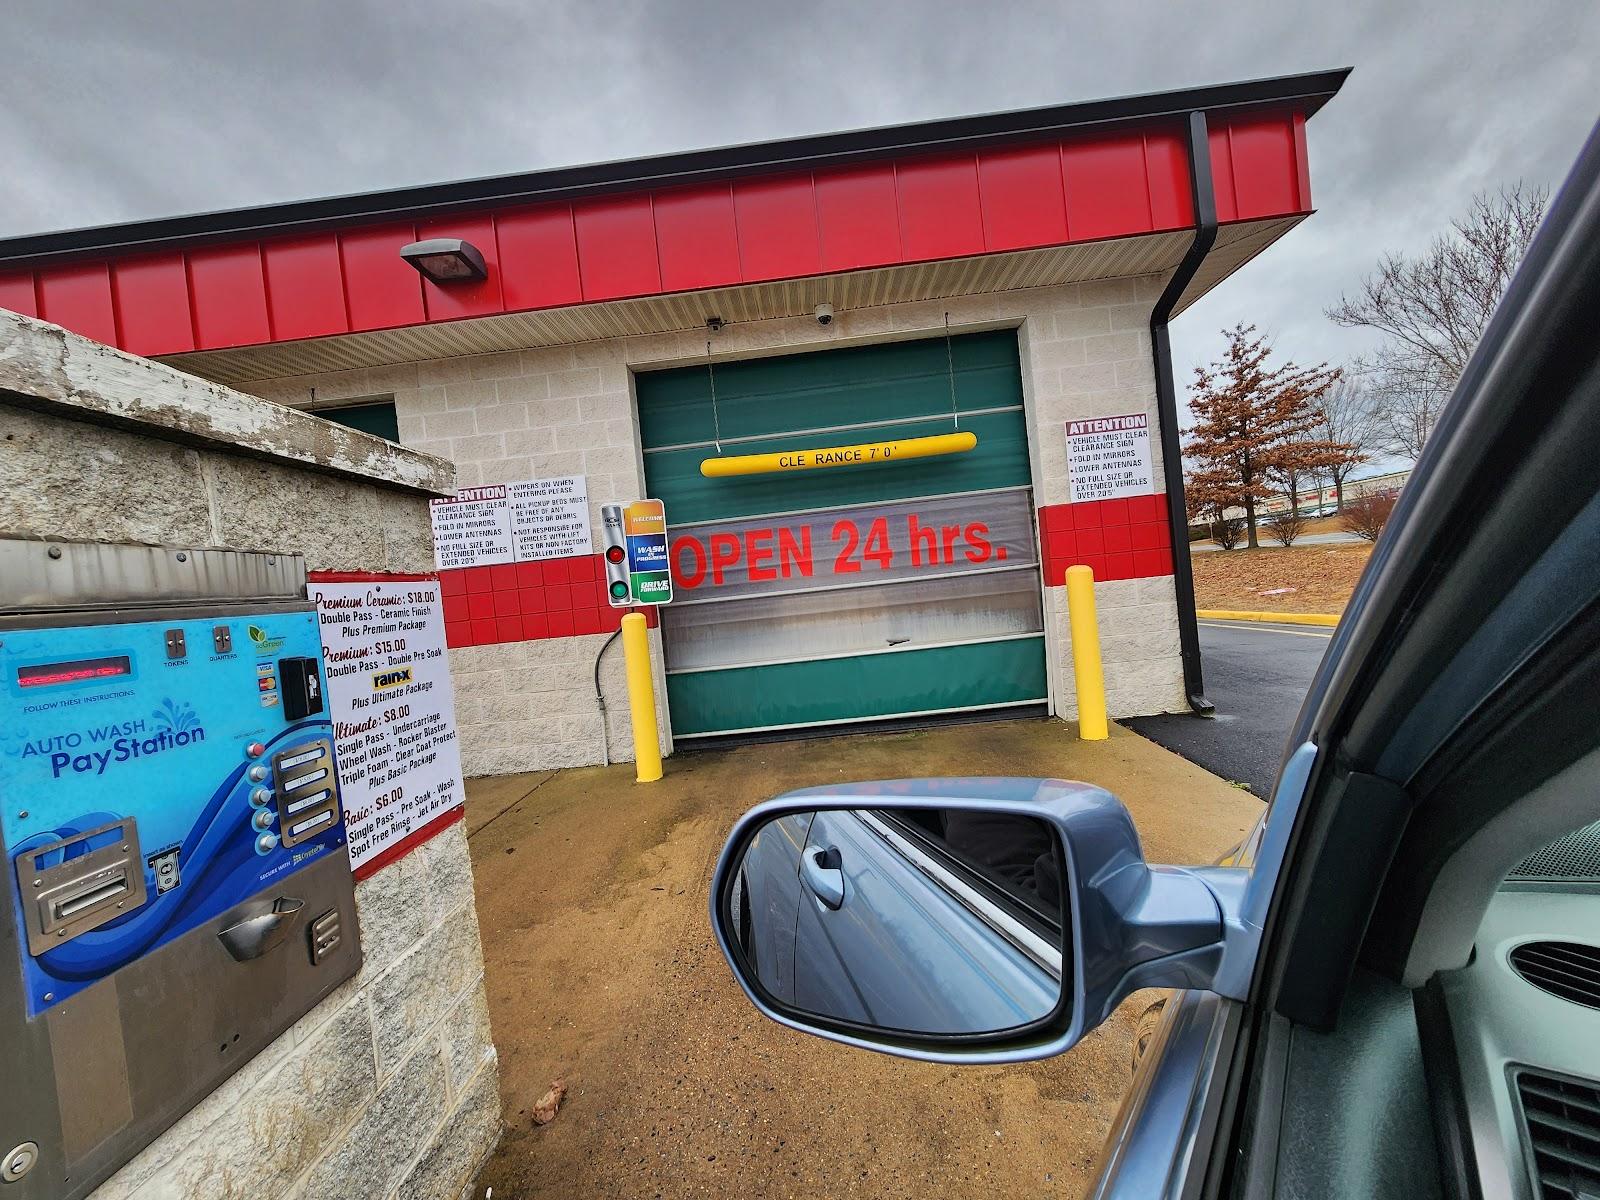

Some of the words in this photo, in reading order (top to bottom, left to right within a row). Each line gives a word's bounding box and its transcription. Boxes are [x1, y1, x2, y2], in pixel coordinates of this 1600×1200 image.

[1070, 415, 1146, 434] ATTENTION
[1073, 435, 1100, 444] VEHICLE
[1125, 431, 1148, 439] CLEAR
[1073, 442, 1114, 452] CLEARANCE
[779, 455, 805, 468] CLE
[815, 449, 862, 464] RANCE
[1103, 450, 1135, 459] MIRRORS
[1075, 464, 1100, 472] LOWER
[1103, 460, 1142, 470] ANTENNAS
[1076, 476, 1086, 484] NO
[1089, 474, 1104, 482] FULL
[1107, 472, 1122, 480] SIZE
[1077, 481, 1112, 492] EXTENDED
[1116, 478, 1148, 487] VEHICLES
[434, 487, 505, 504] ENTION
[514, 490, 546, 498] ENTERING
[1078, 491, 1095, 499] OVER
[466, 503, 484, 511] MUST
[438, 512, 476, 521] CLEARANCE
[517, 516, 543, 524] OBJECTS
[633, 515, 664, 523] WELCOME
[466, 520, 496, 528] MIRRORS
[465, 529, 502, 538] ANTENNAS
[520, 535, 549, 543] VEHICLES
[561, 538, 588, 546] FACTORY
[638, 545, 665, 553] WASH
[442, 550, 475, 559] EXTENDED
[477, 547, 508, 555] VEHICLES
[521, 550, 552, 558] INSTALLED
[670, 525, 814, 590] OPEN
[831, 516, 894, 575] 24
[908, 513, 1008, 568] hrs.
[641, 580, 669, 588] DRIVE
[315, 592, 363, 610] Premium
[366, 590, 405, 607] Ceramic:
[407, 591, 435, 603] $18.00
[321, 611, 350, 624] Double
[353, 610, 373, 621] Pass
[381, 608, 409, 619] Ceramic
[412, 606, 431, 616] Finish
[342, 626, 360, 638] Plus
[363, 623, 396, 635] Premium
[398, 620, 426, 632] Package
[210, 653, 237, 662] QUARTERS
[322, 646, 373, 663] Premium:
[375, 639, 405, 655] $15.00
[327, 665, 356, 679] Double
[359, 662, 378, 672] Pass
[388, 654, 411, 666] Double
[414, 651, 425, 661] Pre
[427, 648, 442, 658] Soak
[352, 695, 369, 710] Plus
[372, 687, 403, 705] Ultimate
[405, 681, 433, 695] Package
[24, 702, 58, 713] FOLLOW
[384, 704, 410, 723] $8.00
[21, 733, 82, 759] AUTO
[88, 719, 146, 743] WASH
[337, 740, 363, 756] Single
[366, 733, 384, 749] Pass
[392, 712, 440, 736] Undercarriage
[51, 726, 205, 778] PayStation
[339, 754, 367, 771] Wheel
[369, 744, 391, 759] Wash
[398, 732, 422, 748] Rocker
[424, 723, 447, 738] Blaster
[341, 768, 365, 786] Triple
[368, 758, 389, 775] Foam
[396, 748, 414, 762] Clear
[416, 741, 431, 753] Coat
[433, 730, 456, 746] Protect
[368, 776, 386, 790] Plus
[388, 766, 407, 781] Basic
[409, 751, 437, 771] Package
[344, 805, 373, 828] Basic:
[376, 786, 403, 811] $6.00
[349, 824, 374, 844] Single
[376, 813, 394, 828] Pass
[401, 801, 413, 815] Pre
[415, 790, 431, 806] Soak
[437, 778, 454, 793] Wash
[351, 841, 370, 859] Spot
[373, 829, 389, 847] Free
[391, 817, 410, 835] Rinse
[418, 805, 429, 818] Jet
[430, 799, 441, 811] Air
[441, 793, 452, 806] Dry
[260, 864, 278, 881] SECURE
[278, 861, 291, 872] WITH
